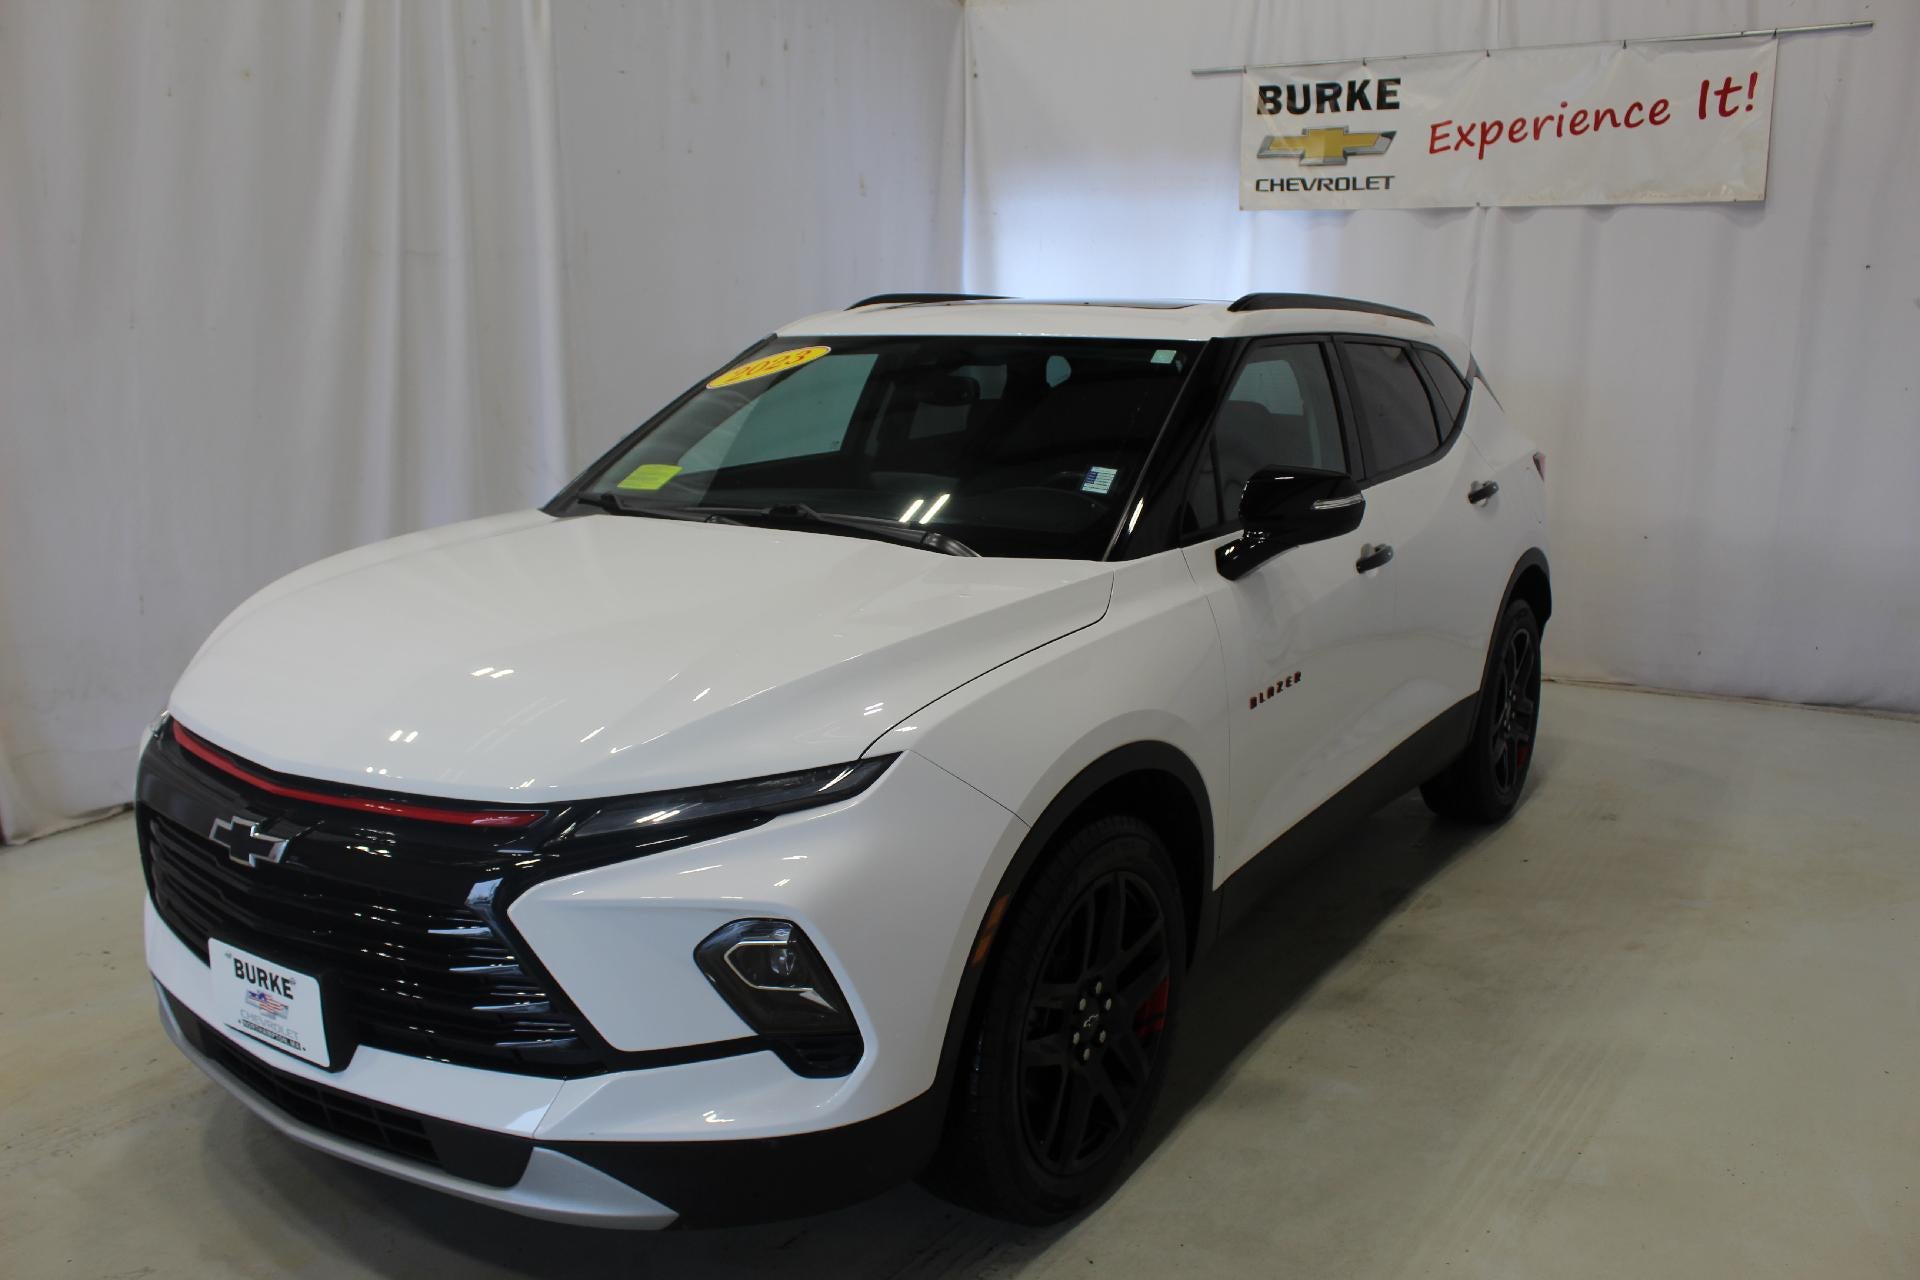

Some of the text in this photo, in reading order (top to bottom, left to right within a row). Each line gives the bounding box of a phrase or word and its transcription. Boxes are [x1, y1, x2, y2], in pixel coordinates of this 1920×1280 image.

[1257, 78, 1401, 115] BURKE
[1428, 71, 1758, 160] Experience It!
[1255, 176, 1395, 192] CHEVROLET
[725, 349, 813, 382] 2023
[1250, 671, 1301, 710] BLAZER
[234, 958, 294, 1000] BURKE
